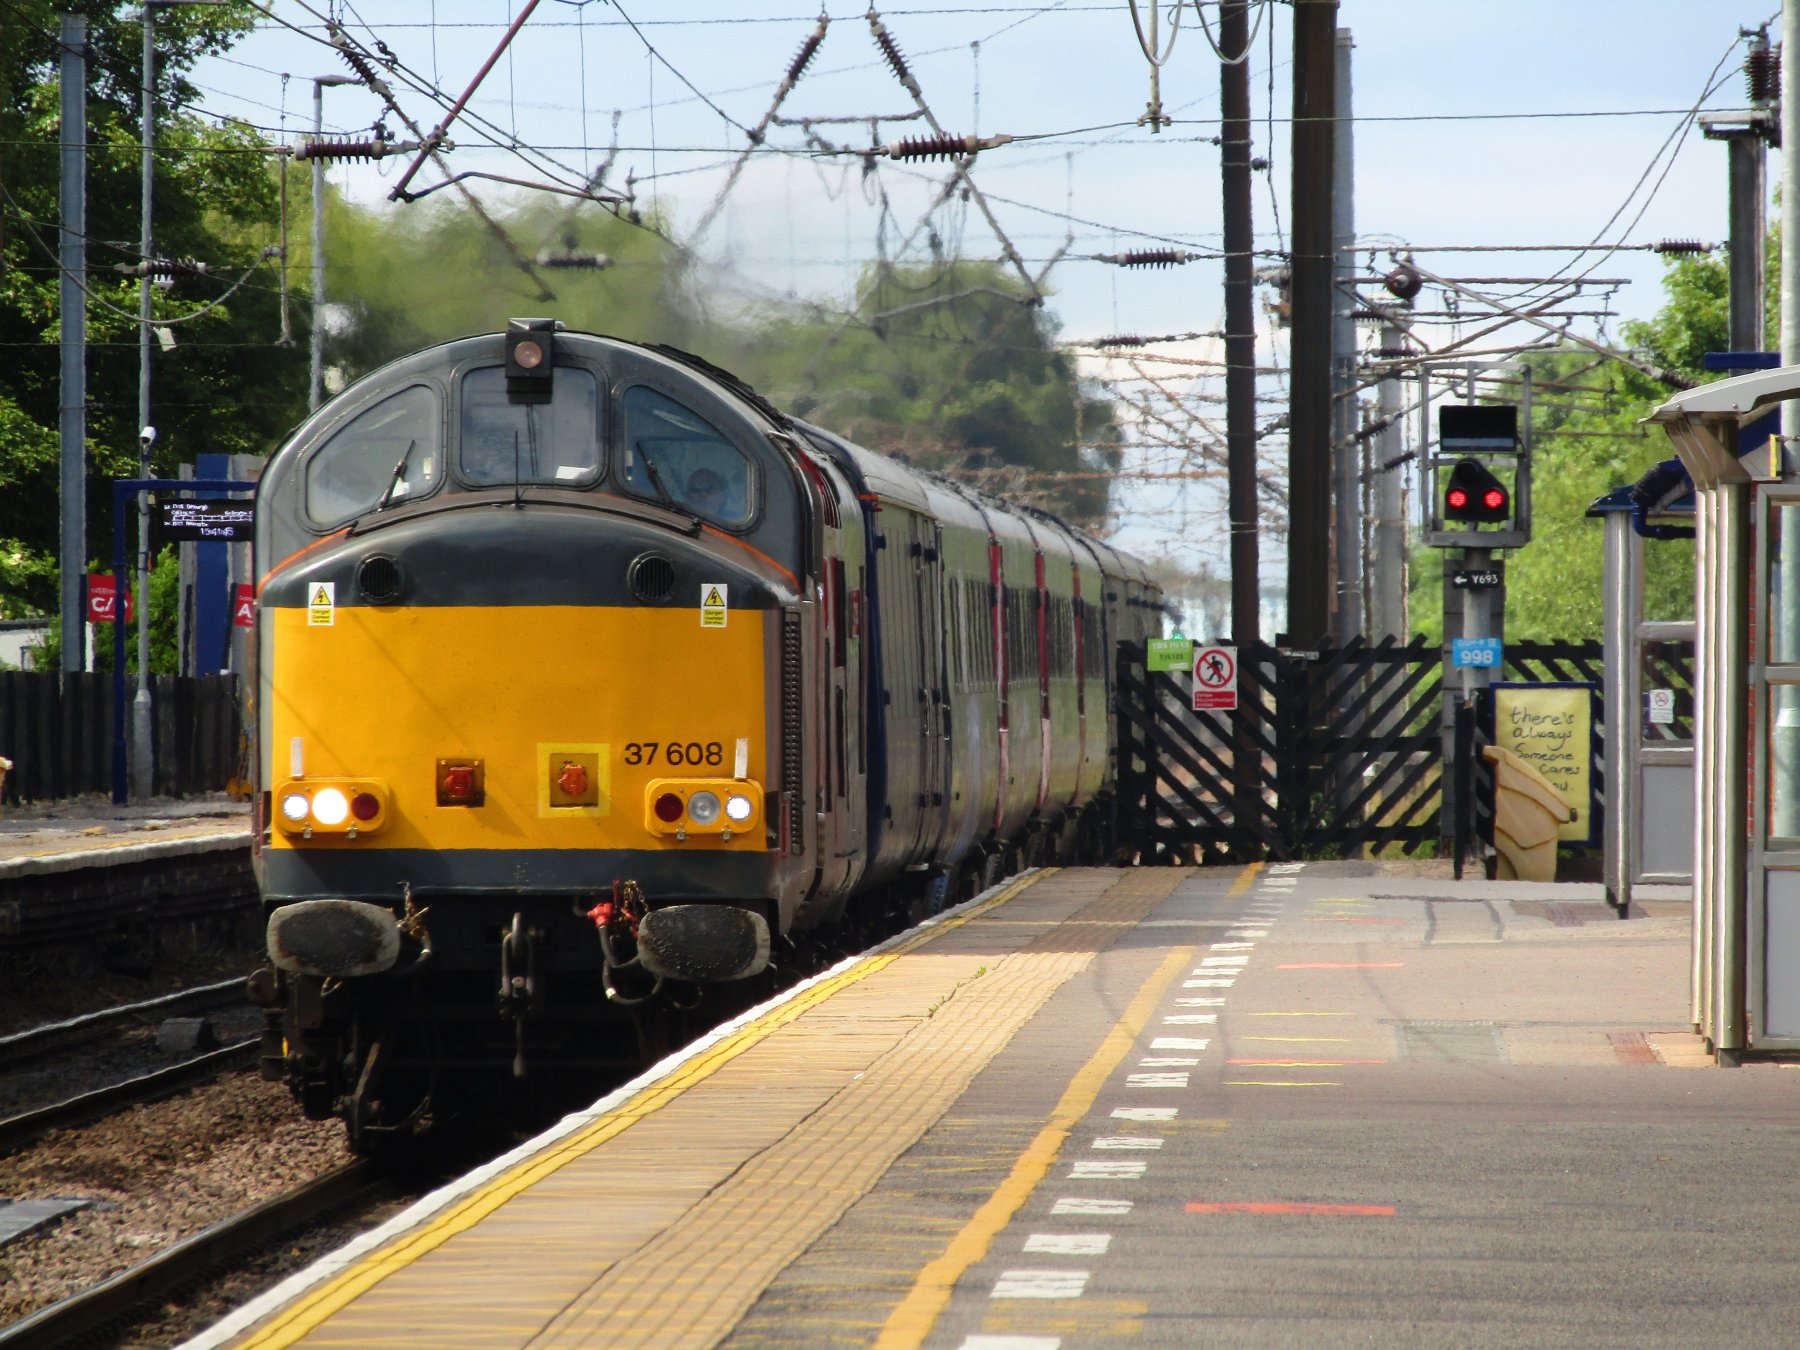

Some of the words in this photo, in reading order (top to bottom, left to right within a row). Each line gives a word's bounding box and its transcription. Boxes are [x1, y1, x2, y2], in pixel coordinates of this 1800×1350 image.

[1472, 574, 1498, 584] Y693
[1461, 650, 1493, 664] 998
[1510, 706, 1575, 725] there's
[624, 742, 659, 765] 37
[666, 742, 723, 765] 608
